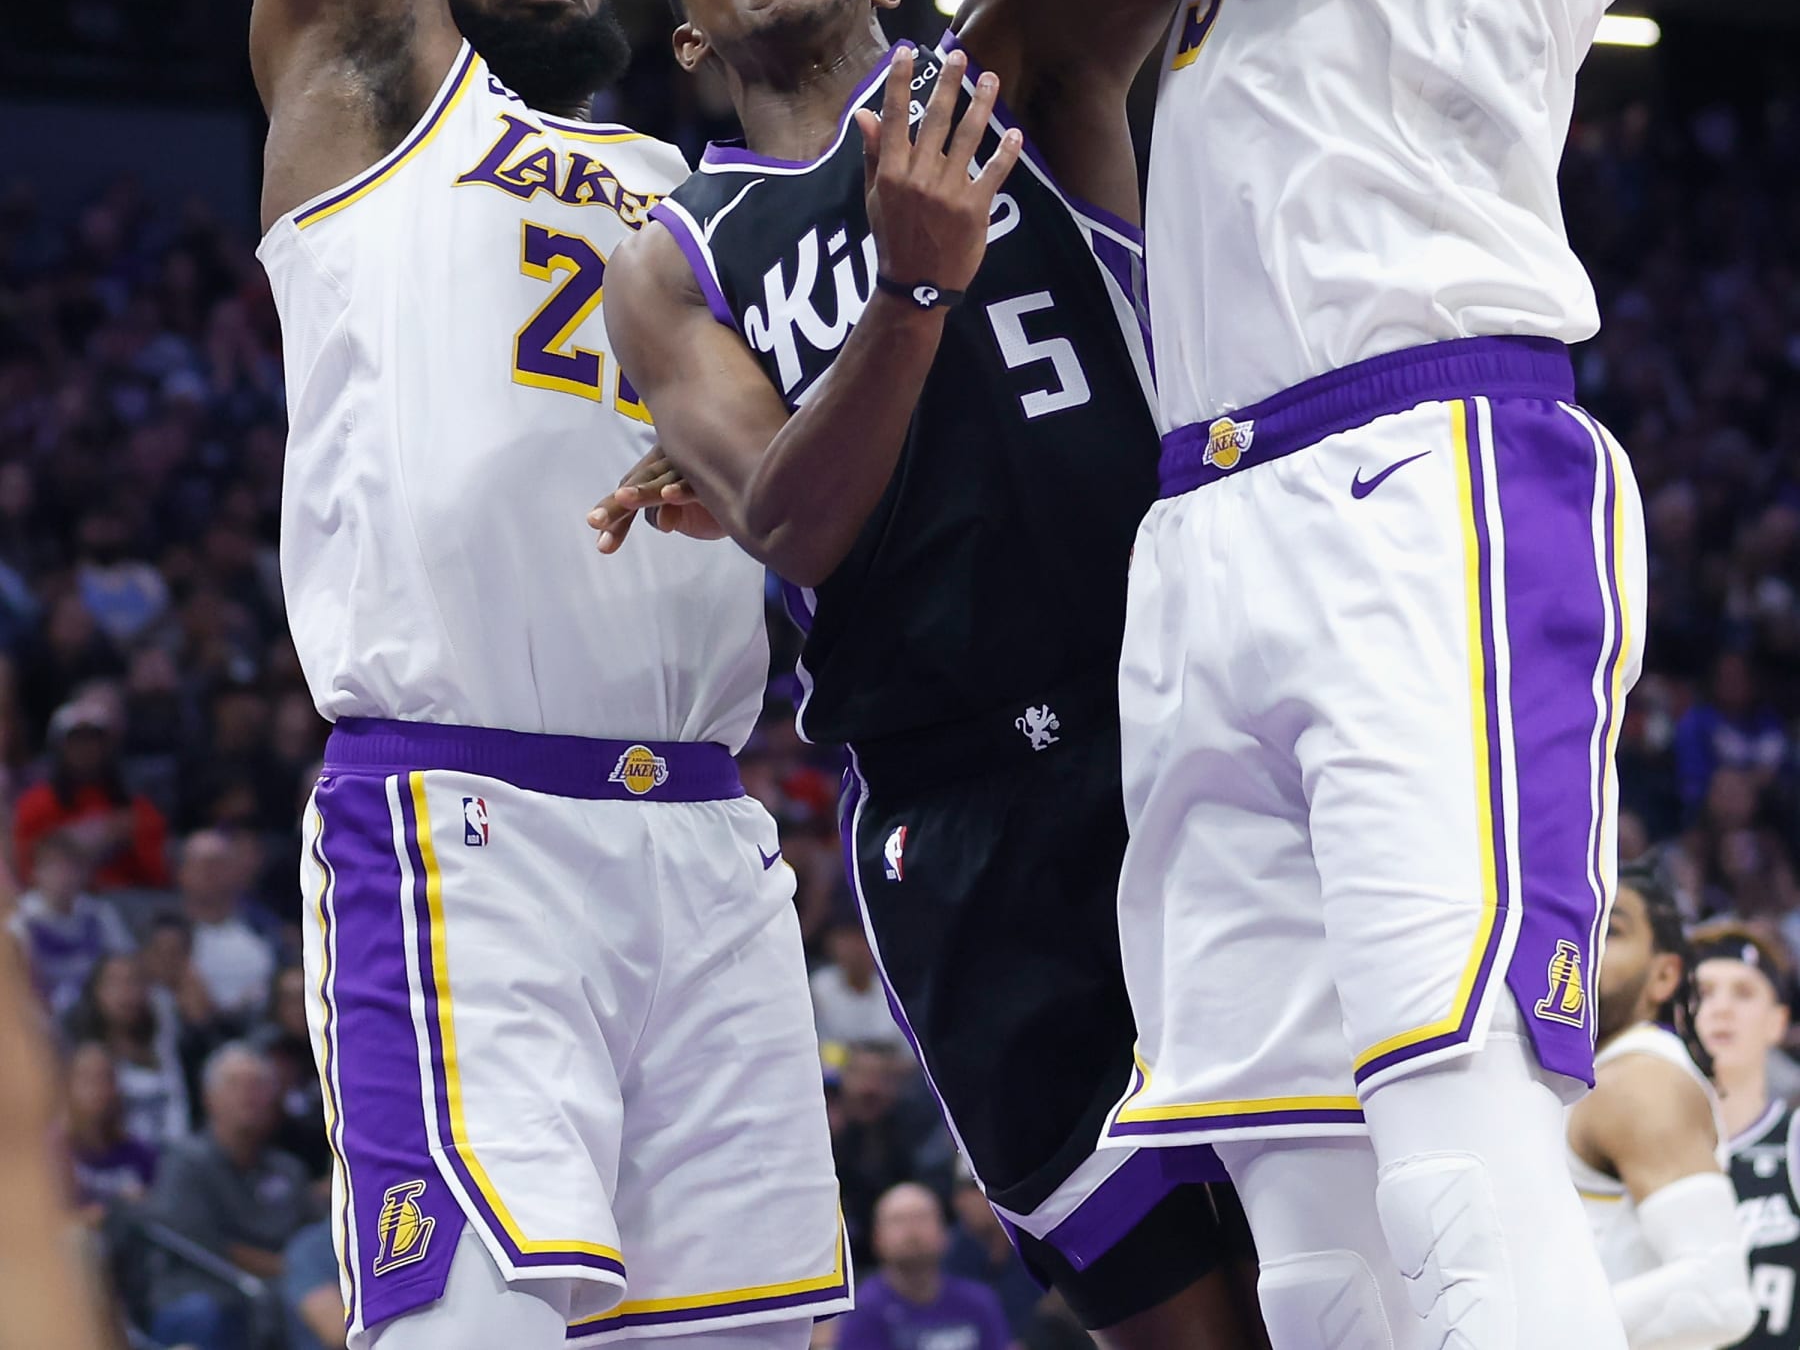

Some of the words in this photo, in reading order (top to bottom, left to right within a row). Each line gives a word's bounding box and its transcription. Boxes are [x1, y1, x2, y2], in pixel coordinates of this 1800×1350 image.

[450, 109, 668, 233] LAKE
[512, 218, 656, 426] 2
[986, 290, 1092, 419] 5
[609, 755, 668, 785] LAKERS
